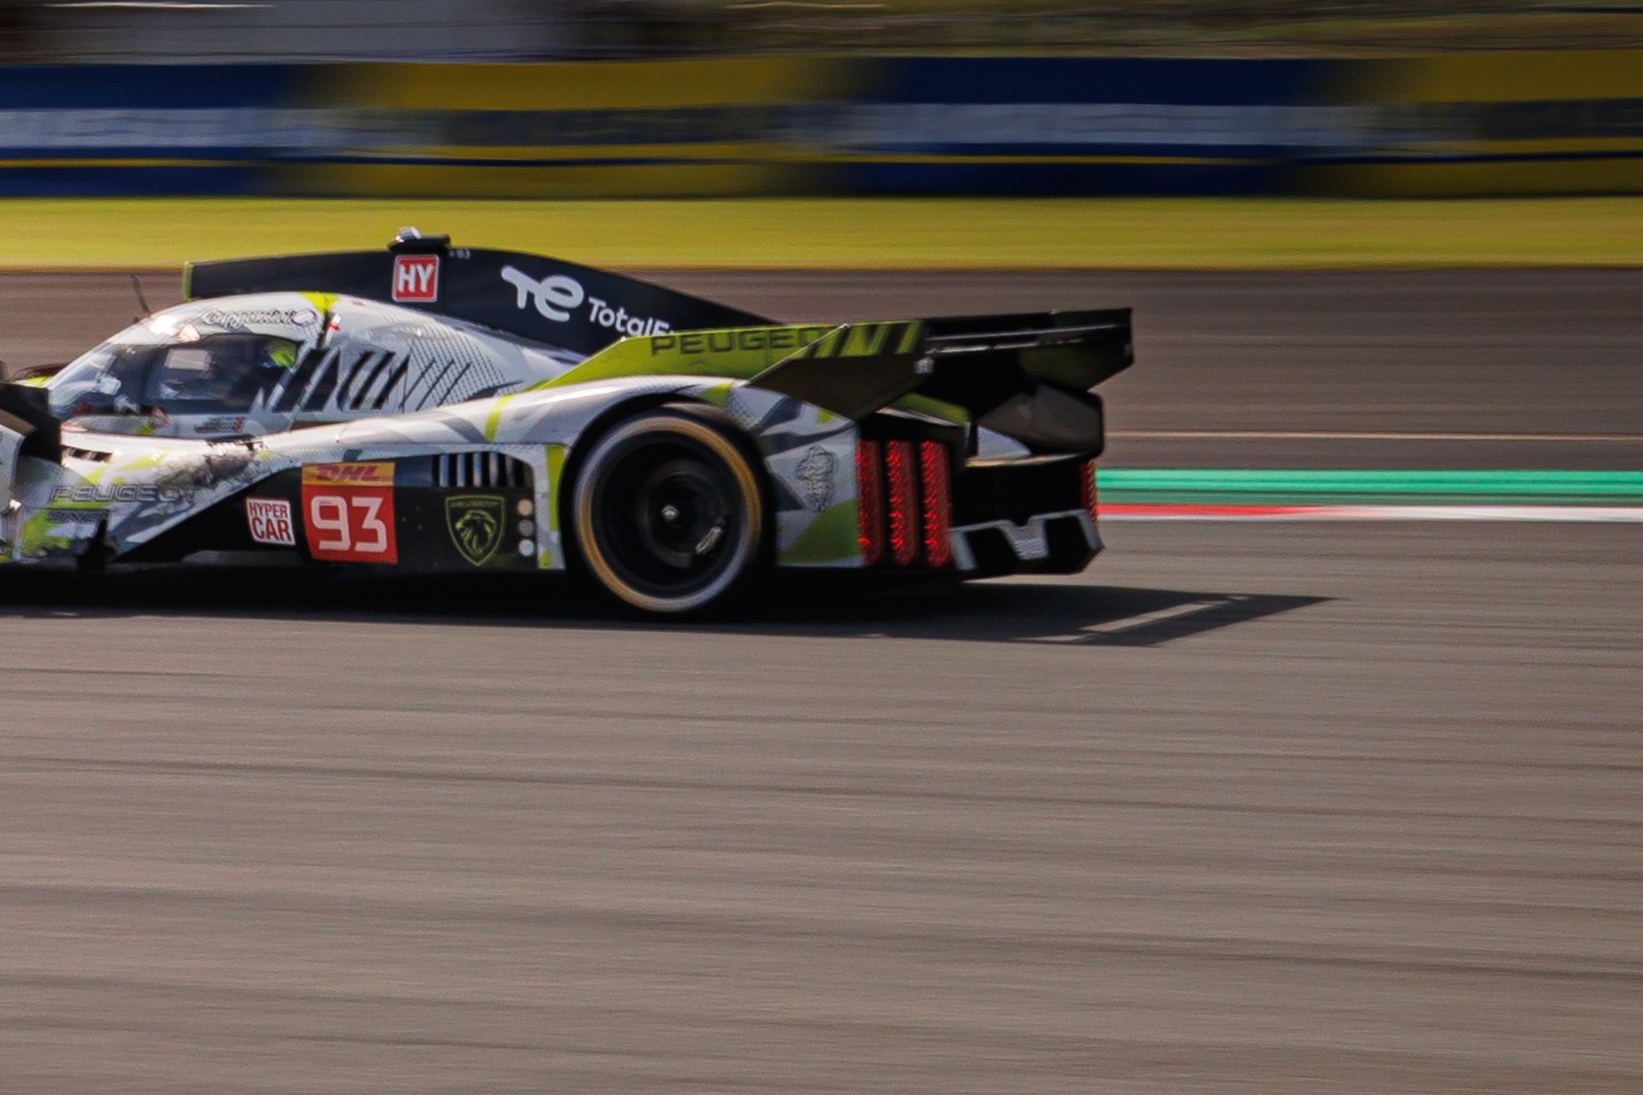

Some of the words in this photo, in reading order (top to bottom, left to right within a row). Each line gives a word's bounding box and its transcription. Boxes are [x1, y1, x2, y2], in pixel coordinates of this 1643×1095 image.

[397, 263, 436, 294] HY
[588, 297, 675, 337] TotalE
[316, 465, 380, 481] DHL
[249, 502, 289, 519] HYPER
[310, 495, 388, 553] 93
[251, 517, 292, 541] CAR
